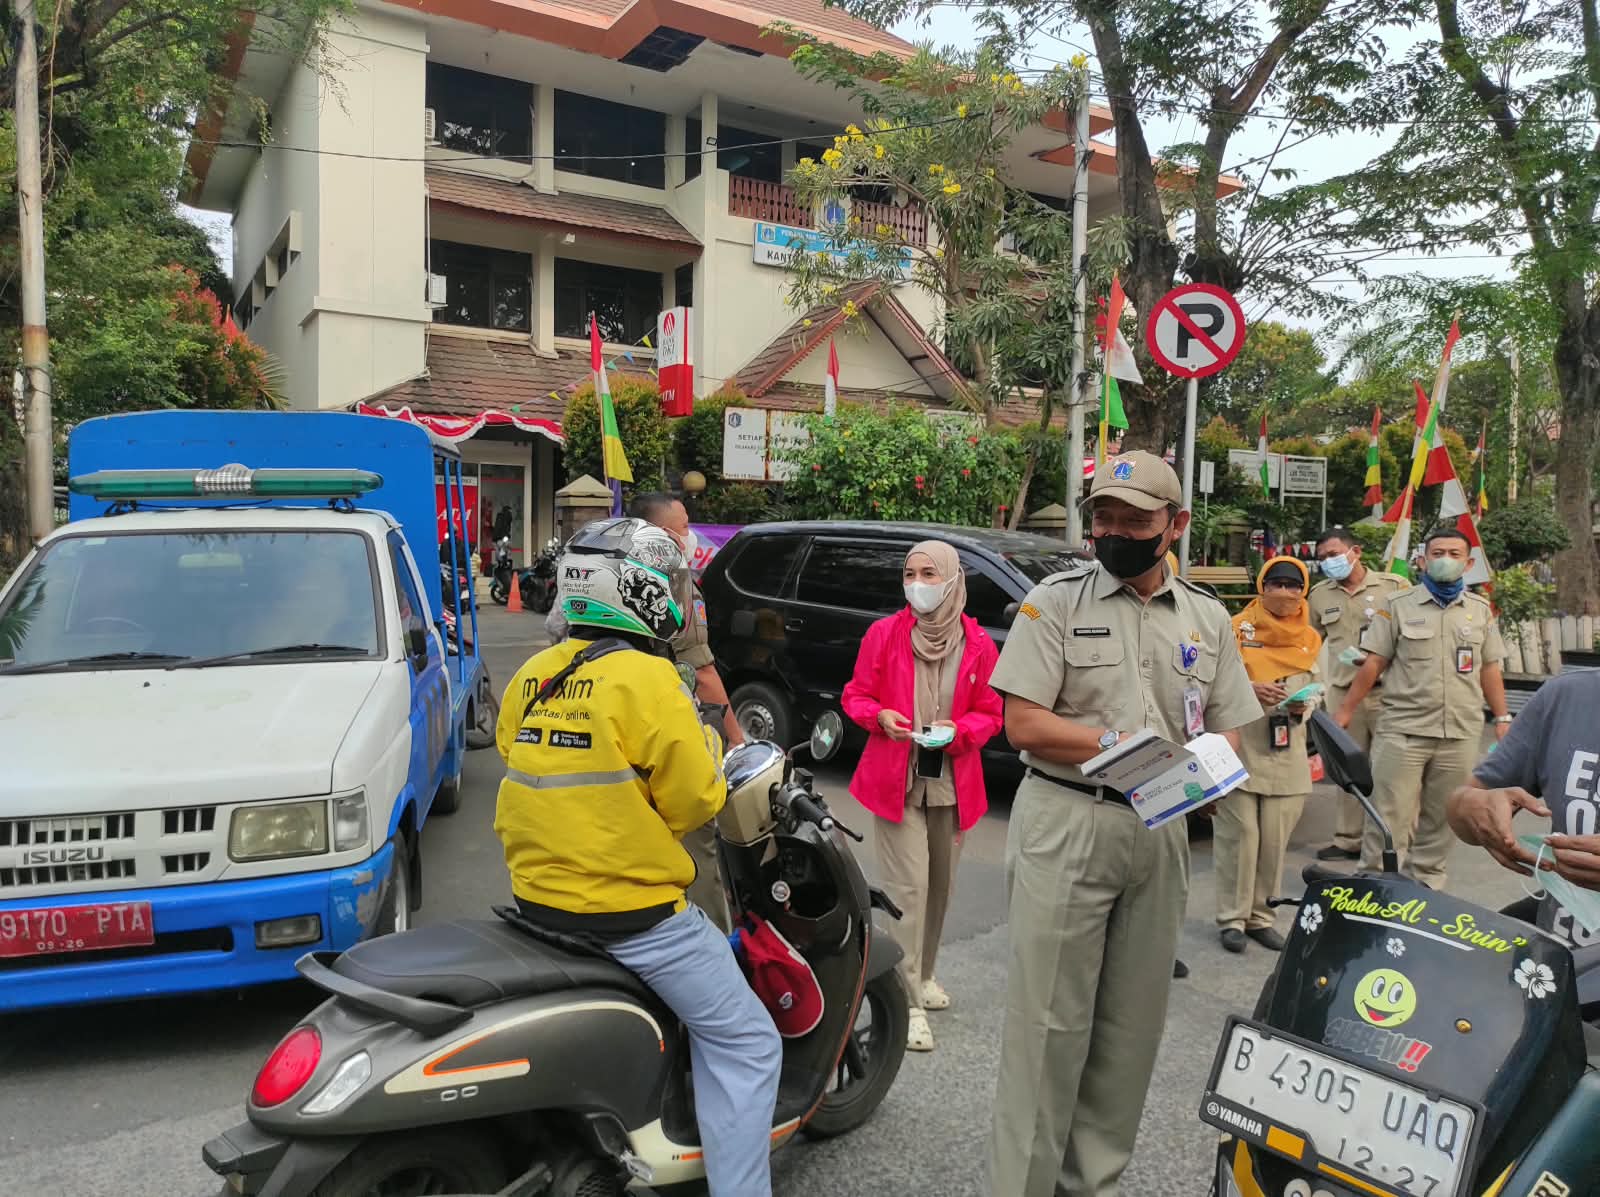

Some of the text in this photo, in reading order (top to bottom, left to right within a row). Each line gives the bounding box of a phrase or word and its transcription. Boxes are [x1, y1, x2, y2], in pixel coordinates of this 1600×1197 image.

[565, 566, 600, 582] KYT
[566, 709, 590, 720] online
[1565, 749, 1600, 801] E
[23, 846, 105, 866] ISUZU
[0, 903, 145, 940] 9170 PTA
[1234, 1036, 1458, 1162] B 4305 UAQ
[1218, 1106, 1262, 1137] YAMAHA
